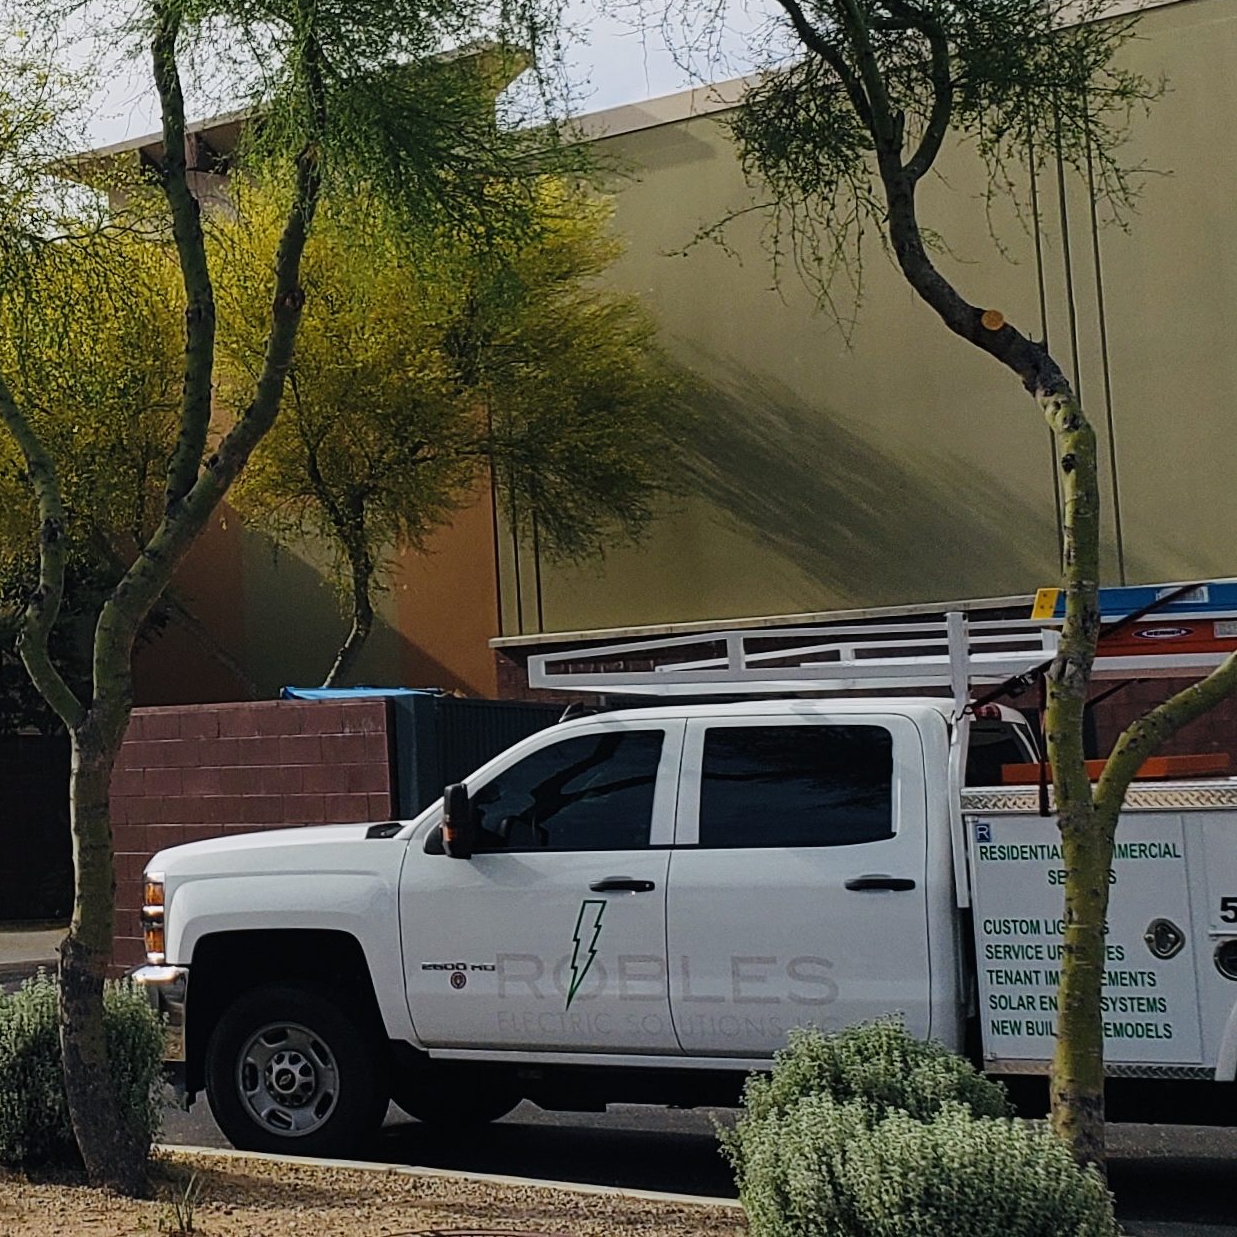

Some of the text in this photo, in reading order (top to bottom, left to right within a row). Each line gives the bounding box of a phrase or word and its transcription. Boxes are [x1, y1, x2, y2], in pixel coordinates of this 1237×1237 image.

[977, 825, 990, 840] R
[1113, 843, 1181, 859] MERCIAL
[983, 919, 1041, 935] CUSTOM
[985, 945, 1044, 961] SERVICE
[496, 953, 839, 1006] ROBLES
[987, 970, 1156, 987] TENANT IMEMENTS
[989, 995, 1036, 1011] SOLAR
[1100, 996, 1167, 1013] SYSTEMS
[498, 1010, 613, 1035] ELECTRIC
[991, 1020, 1022, 1037] NEW
[1105, 1022, 1173, 1038] EMODELS
